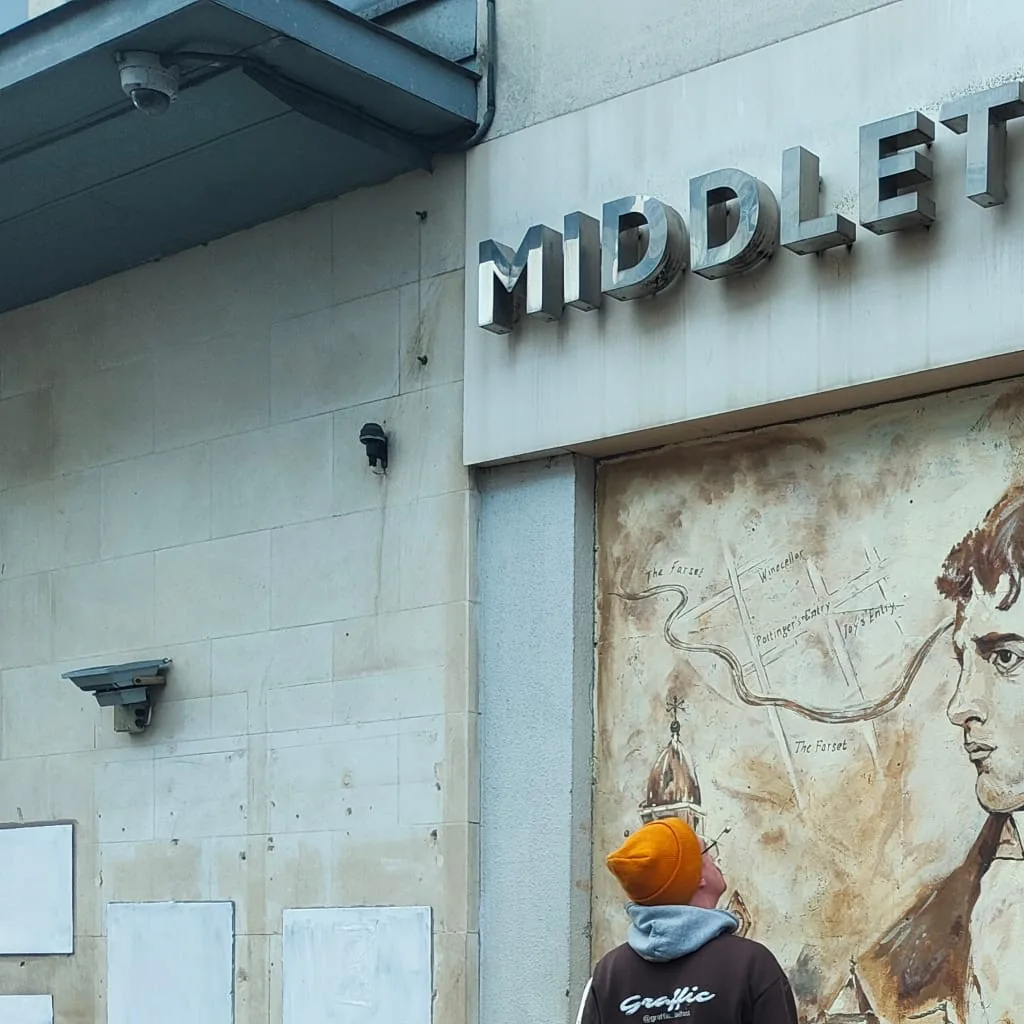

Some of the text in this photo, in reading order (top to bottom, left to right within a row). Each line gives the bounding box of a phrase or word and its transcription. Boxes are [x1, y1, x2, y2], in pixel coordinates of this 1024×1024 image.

[645, 567, 664, 584] The
[804, 601, 831, 622] Entry
[795, 739, 847, 753] The Farset
